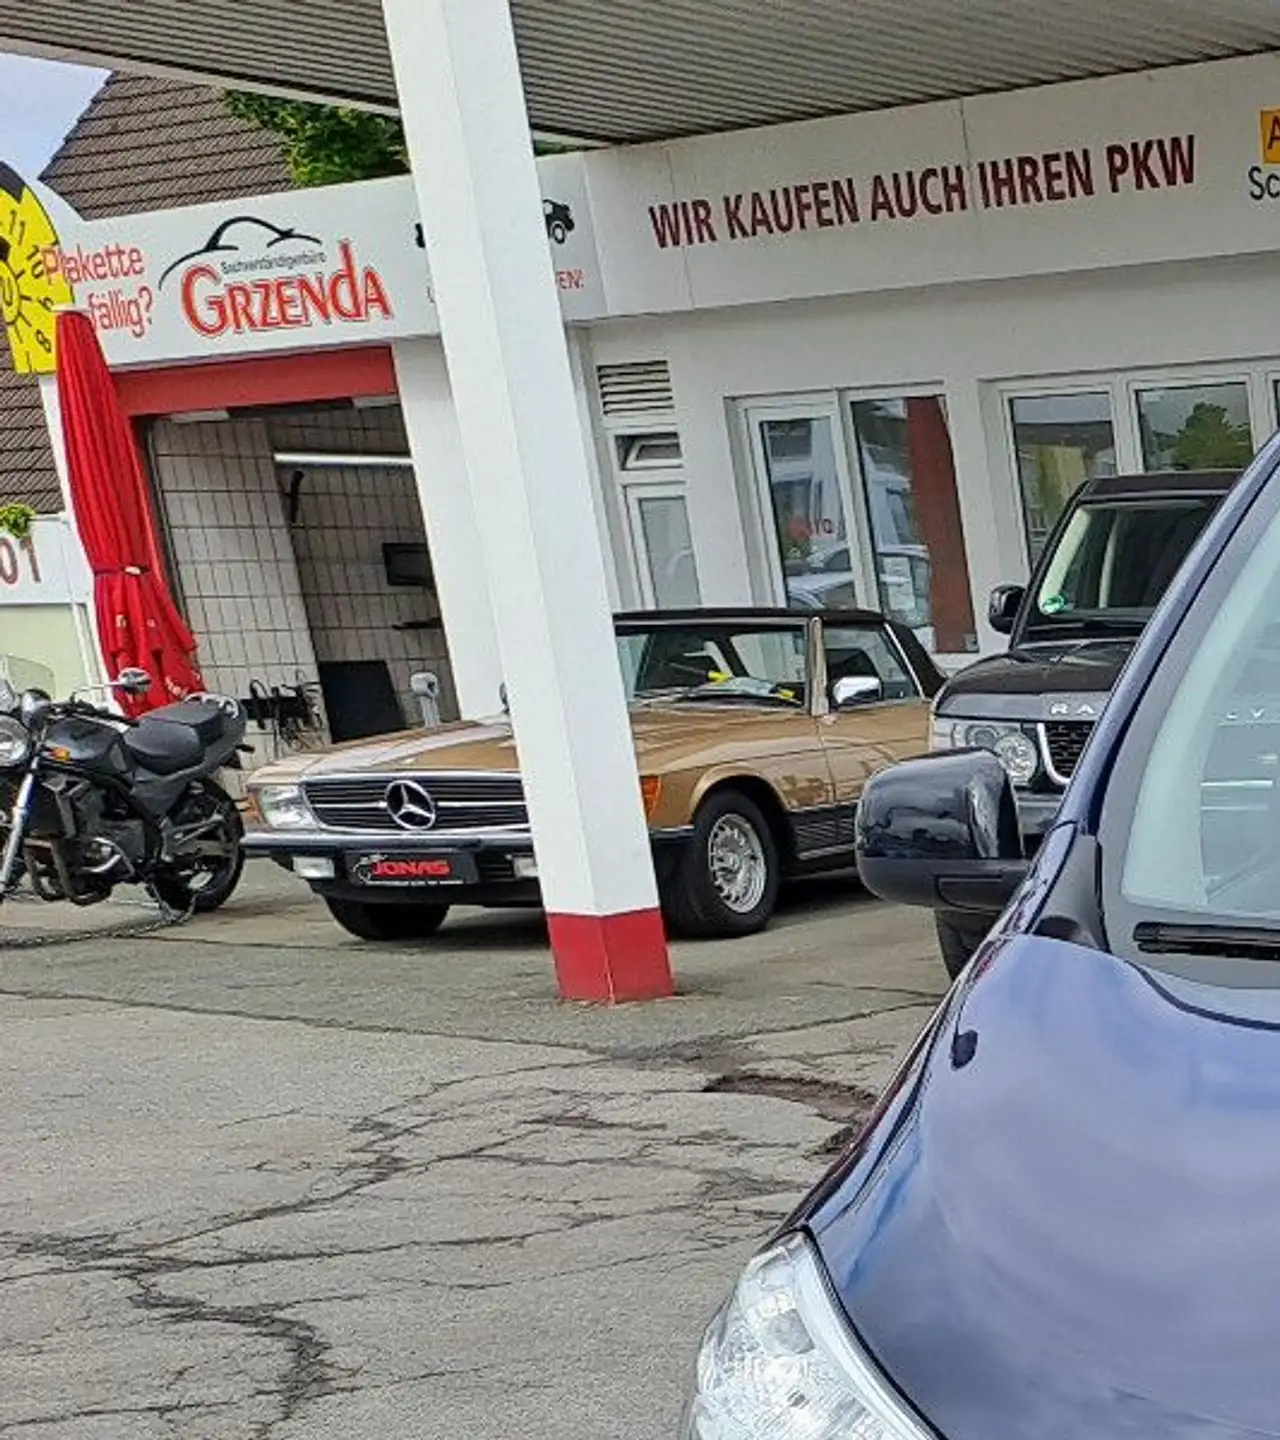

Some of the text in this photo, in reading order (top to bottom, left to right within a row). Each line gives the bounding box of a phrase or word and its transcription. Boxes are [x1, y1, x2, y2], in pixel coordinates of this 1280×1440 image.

[648, 134, 1195, 248] WIR KAUFEN AUCH IHREN PKW
[41, 243, 146, 284] Plakette
[87, 286, 153, 338] fällig?
[371, 859, 451, 877] JONAS
